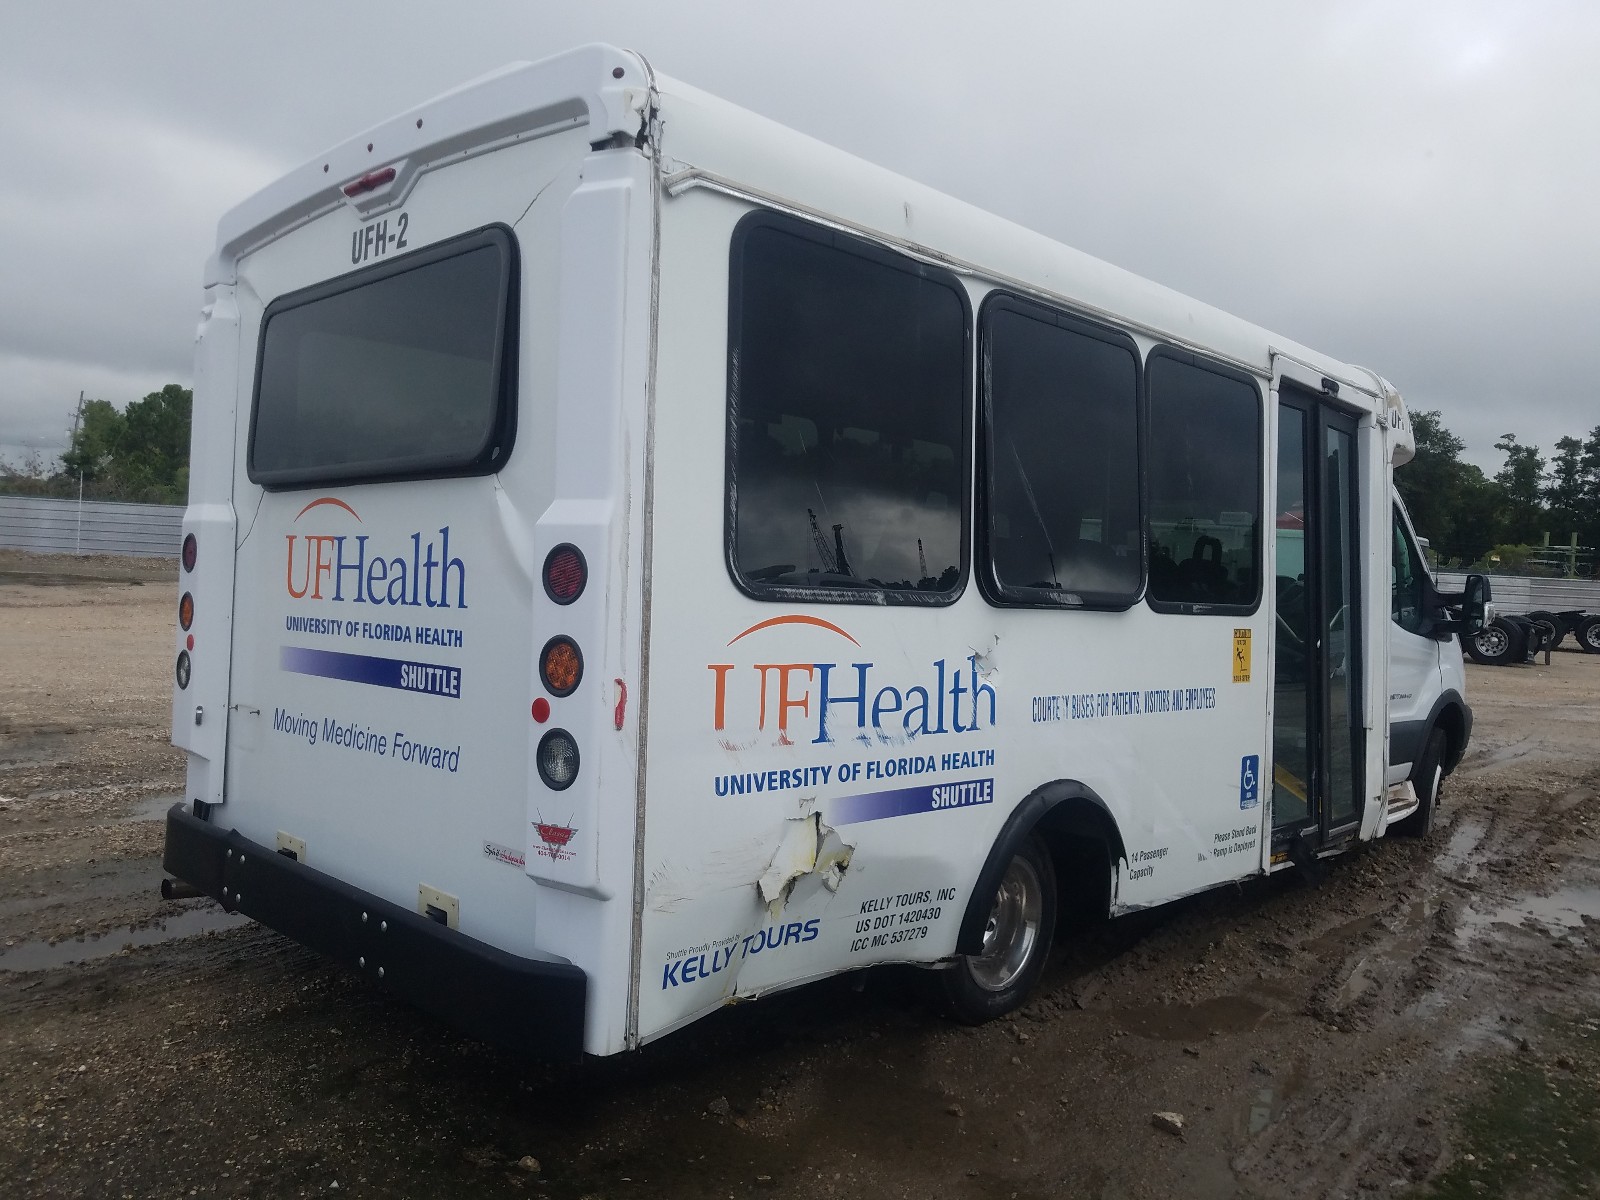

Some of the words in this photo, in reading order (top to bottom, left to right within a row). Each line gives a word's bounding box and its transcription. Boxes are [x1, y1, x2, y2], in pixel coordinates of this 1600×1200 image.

[351, 212, 409, 264] UFH-2
[286, 615, 343, 637] UNIVERSITY
[345, 620, 360, 638] OF
[362, 622, 412, 643] FLORIDA
[415, 628, 463, 648] HEALTH
[400, 663, 459, 696] SHUTTLE
[1032, 694, 1070, 723] COURTEY
[1072, 693, 1095, 720] BUSES
[1096, 692, 1110, 718] FOR
[1111, 691, 1142, 716] PATIENTS,
[1144, 689, 1170, 714] VISITORS
[1171, 689, 1184, 712] AND
[1185, 687, 1216, 711] EMPLOYEES
[274, 707, 319, 745] Moving
[322, 717, 387, 756] Medicine
[391, 732, 460, 773] Forward
[714, 765, 832, 797] UNIVERSITY
[838, 762, 861, 783] OF
[866, 755, 937, 780] FLORIDA
[941, 750, 995, 771] HEALTH
[931, 781, 991, 810] SHUTTLE
[1213, 832, 1231, 844] Please
[1231, 827, 1245, 840] Stand
[1245, 824, 1257, 836] Back
[1131, 852, 1139, 863] 14
[1139, 847, 1169, 862] Passenger
[1213, 846, 1227, 858] Ramp
[1233, 839, 1256, 854] Deployed
[1129, 865, 1155, 881] Capacity
[860, 896, 893, 914] KELLY
[895, 890, 932, 908] TOURS,
[936, 887, 956, 901] INC
[855, 918, 871, 934] US
[873, 914, 896, 930] DOT
[898, 907, 942, 925] 1420430
[666, 948, 687, 961] Shuttle
[688, 943, 711, 955] Proudly
[711, 936, 734, 949] Provided
[849, 937, 869, 953] ICC
[870, 933, 889, 948] MC
[890, 926, 928, 945] 537279
[662, 942, 738, 991] KELLY
[741, 918, 821, 960] TOURS
